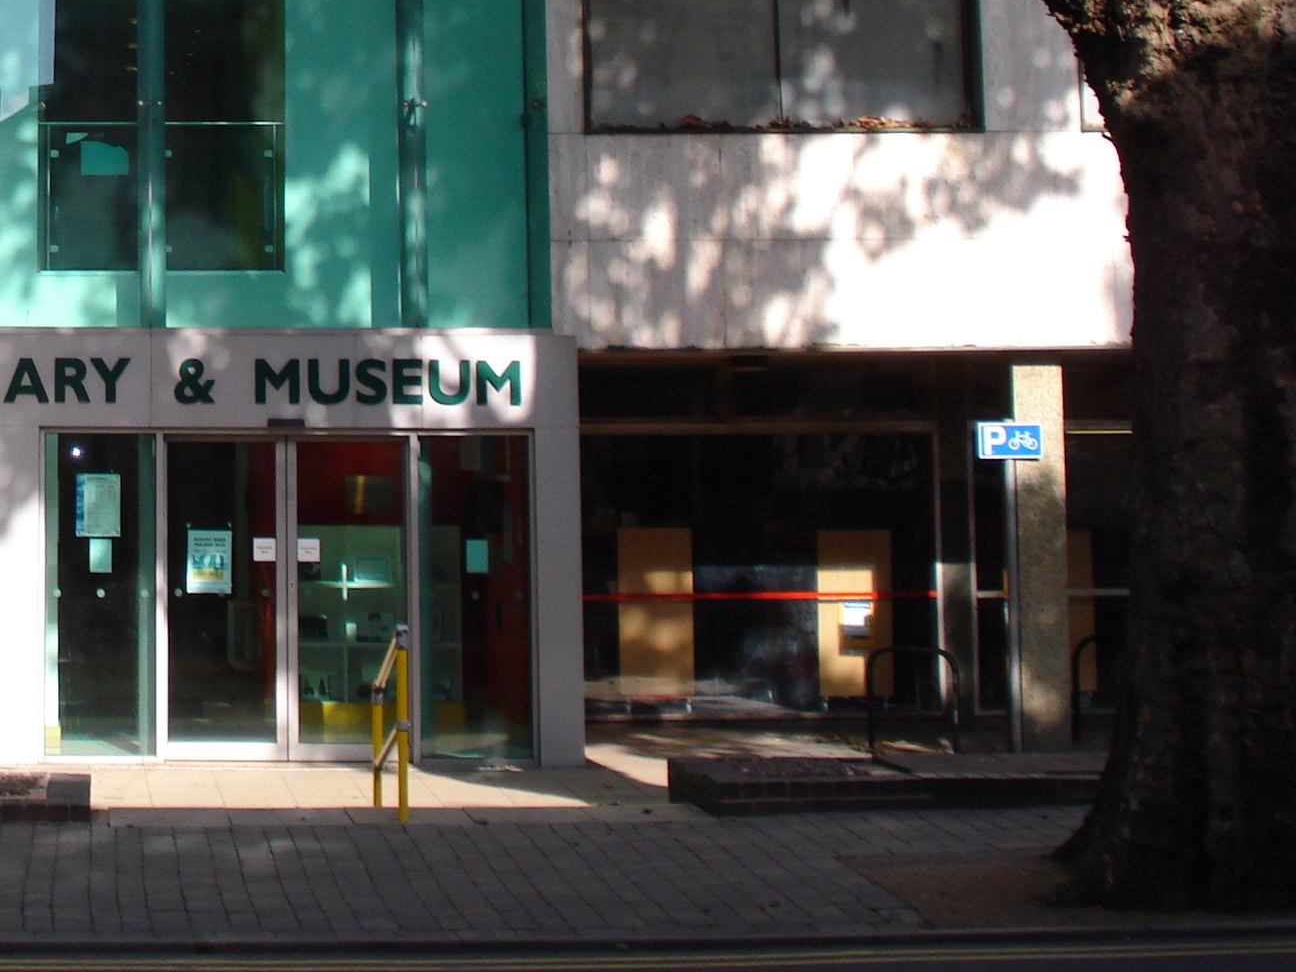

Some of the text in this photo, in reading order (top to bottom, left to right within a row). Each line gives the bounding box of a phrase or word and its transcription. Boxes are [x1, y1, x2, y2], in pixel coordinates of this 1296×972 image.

[174, 359, 215, 405] &
[255, 358, 521, 406] MUSEUM
[984, 426, 1007, 456] P
